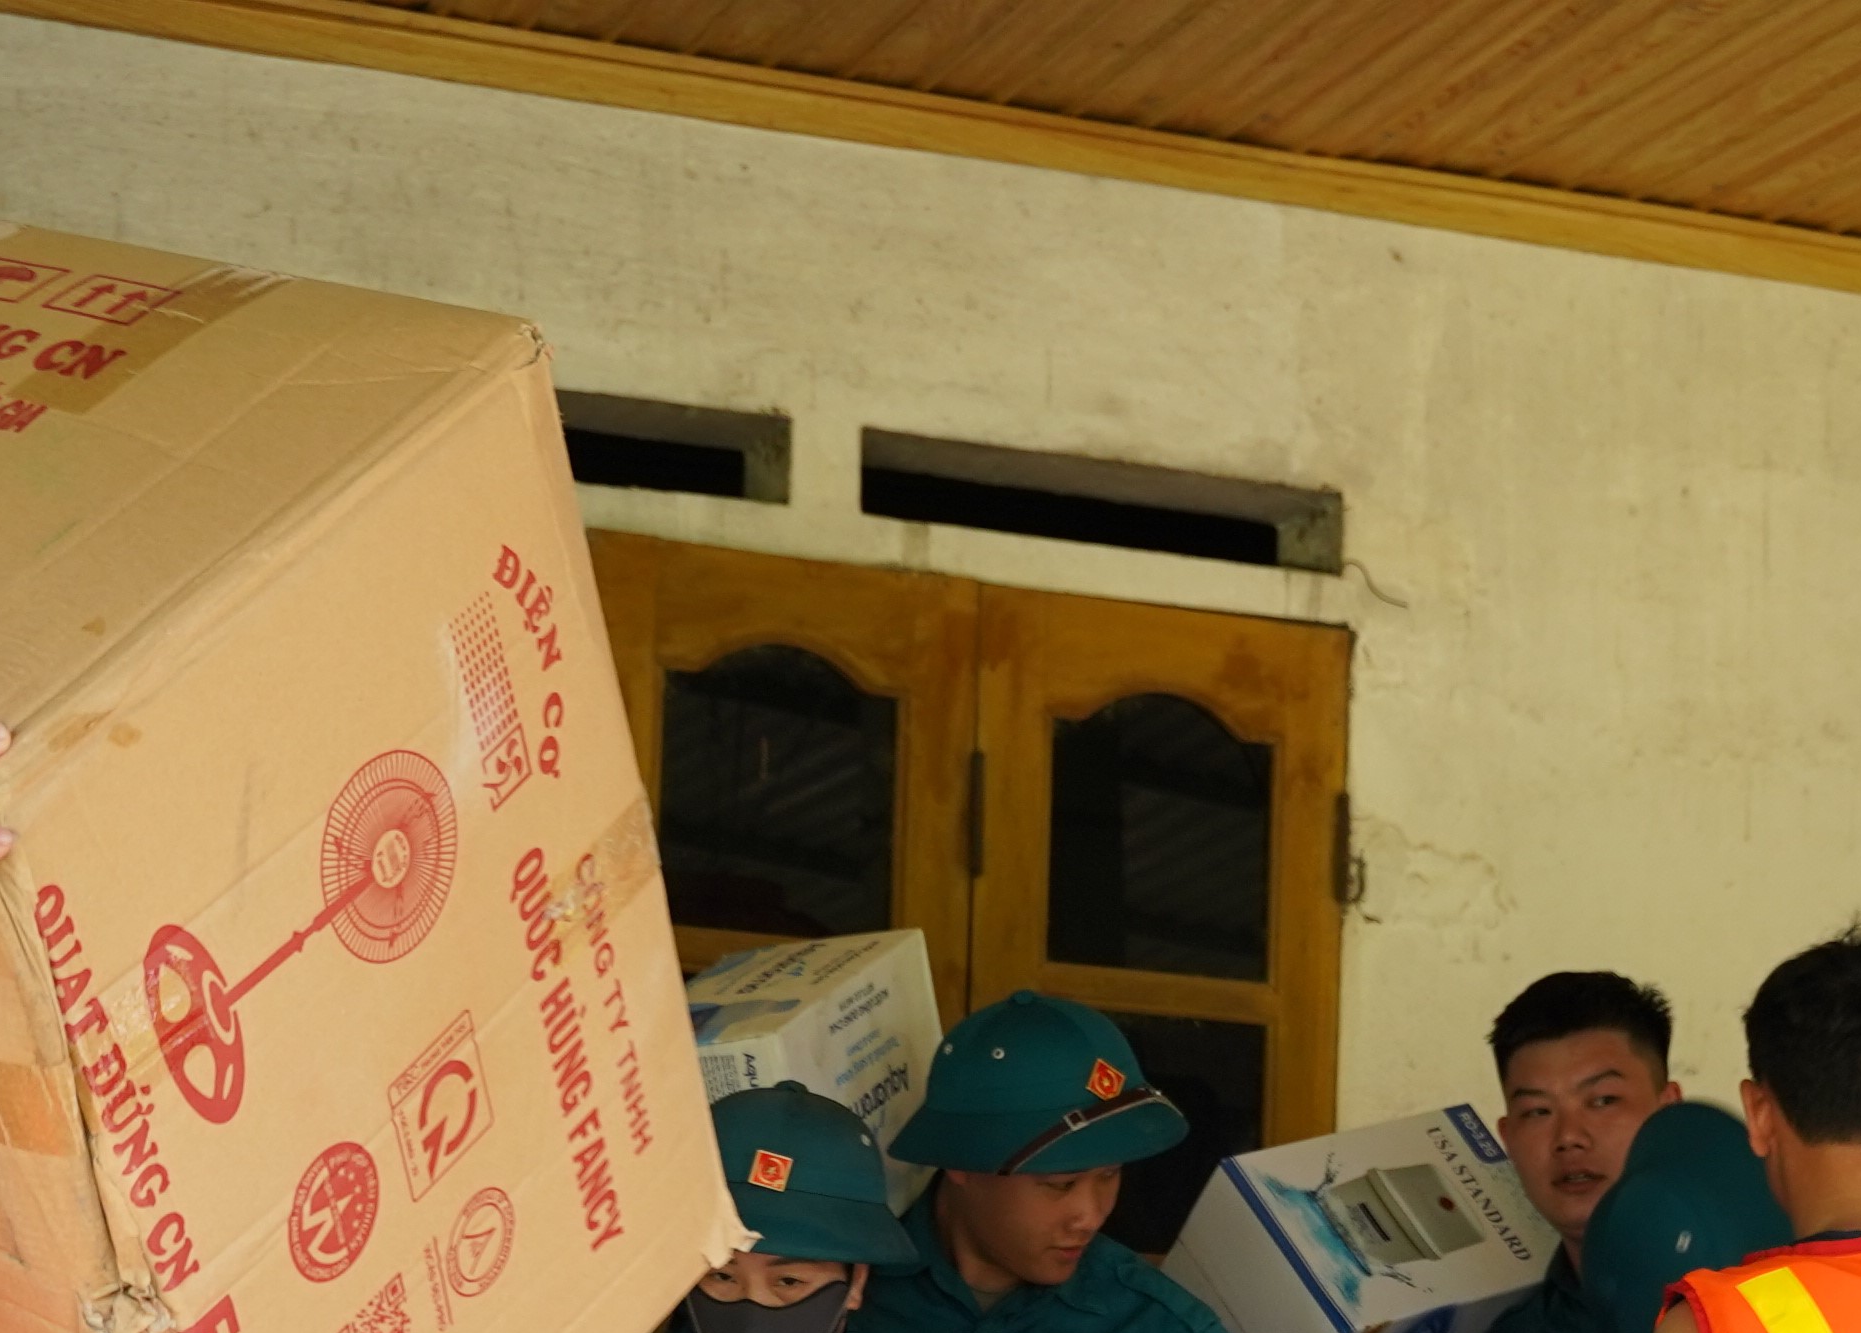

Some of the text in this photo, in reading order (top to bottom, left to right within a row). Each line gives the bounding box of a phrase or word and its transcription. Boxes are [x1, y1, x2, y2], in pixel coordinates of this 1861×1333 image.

[34, 340, 123, 378] CN
[492, 544, 562, 671] ĐIỆN
[604, 979, 631, 1033] TY
[540, 976, 593, 1118] HÙNG
[568, 1107, 625, 1252] FANCY
[617, 1040, 654, 1156] TNHH
[83, 1043, 171, 1211] ĐỨNG
[146, 1211, 200, 1293] CN
[1425, 1126, 1533, 1264] USA STANDARD
